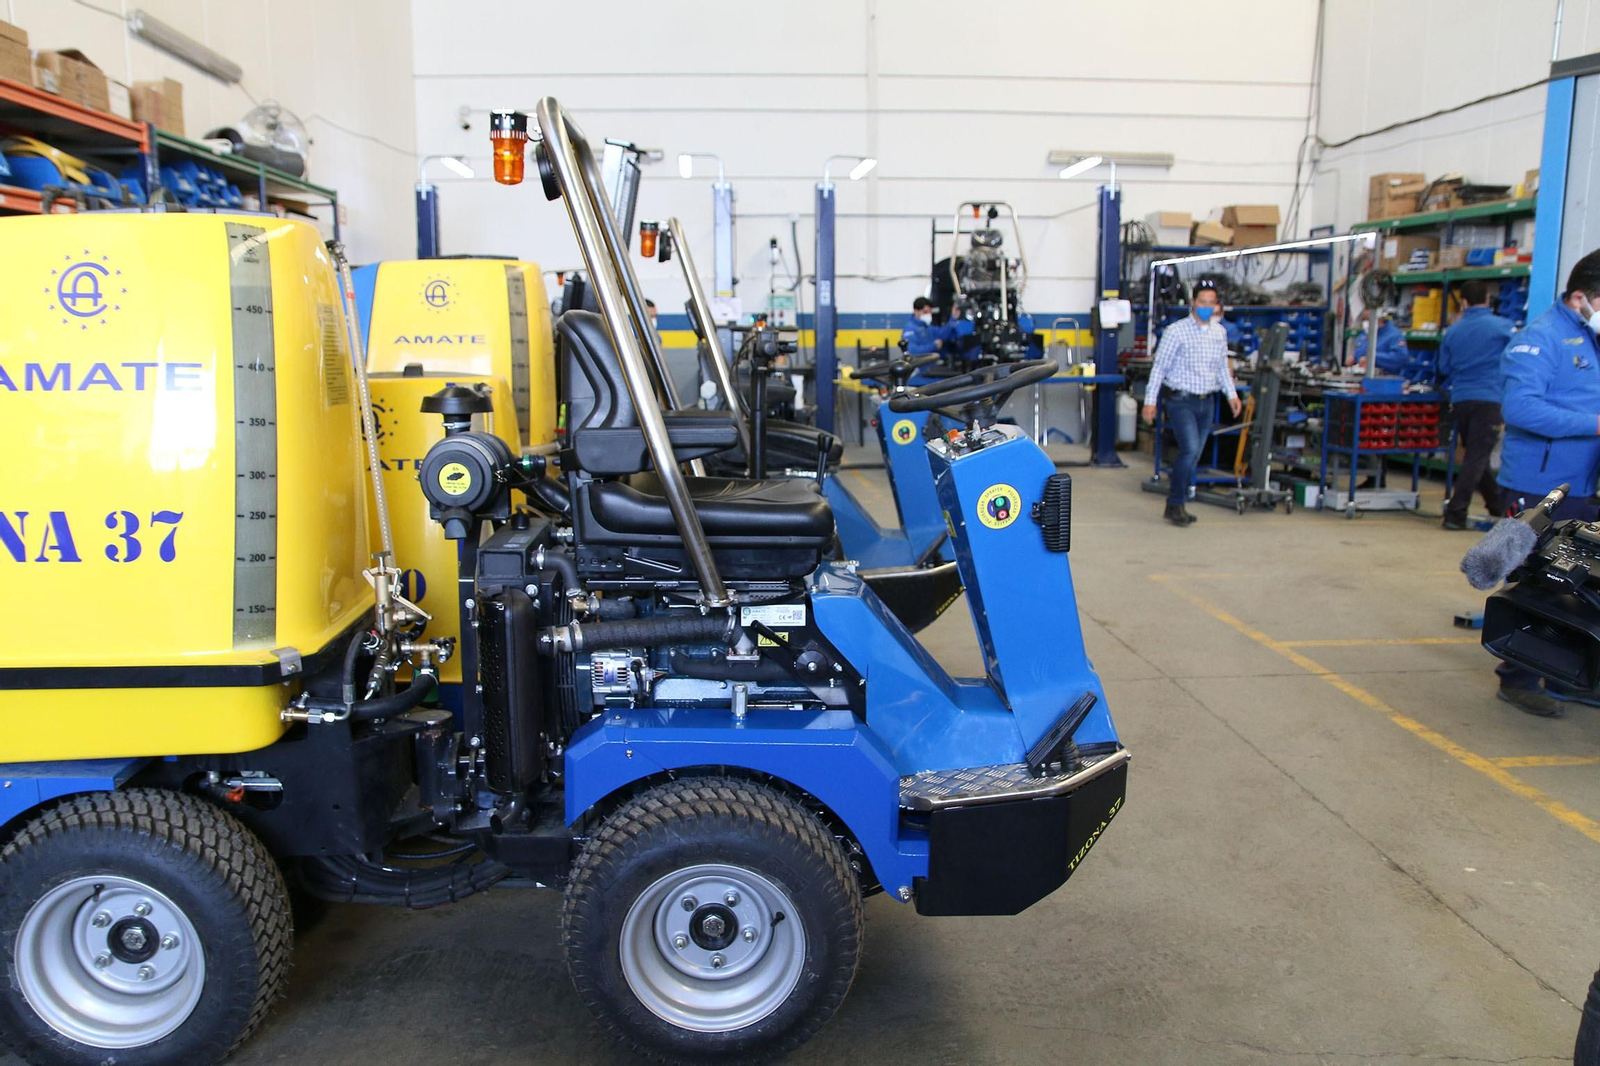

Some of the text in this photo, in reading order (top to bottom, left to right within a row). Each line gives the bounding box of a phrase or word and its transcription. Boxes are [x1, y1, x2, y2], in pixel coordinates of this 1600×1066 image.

[246, 305, 263, 314] 450
[394, 335, 486, 344] AMATE
[248, 362, 265, 372] 400
[248, 418, 266, 427] 350
[249, 471, 266, 480] 300
[249, 511, 266, 520] 250
[105, 510, 184, 562] 37
[249, 553, 266, 562] 200
[1547, 574, 1564, 583] SONY
[248, 605, 266, 614] 150
[1067, 796, 1122, 870] TIZONA 37
